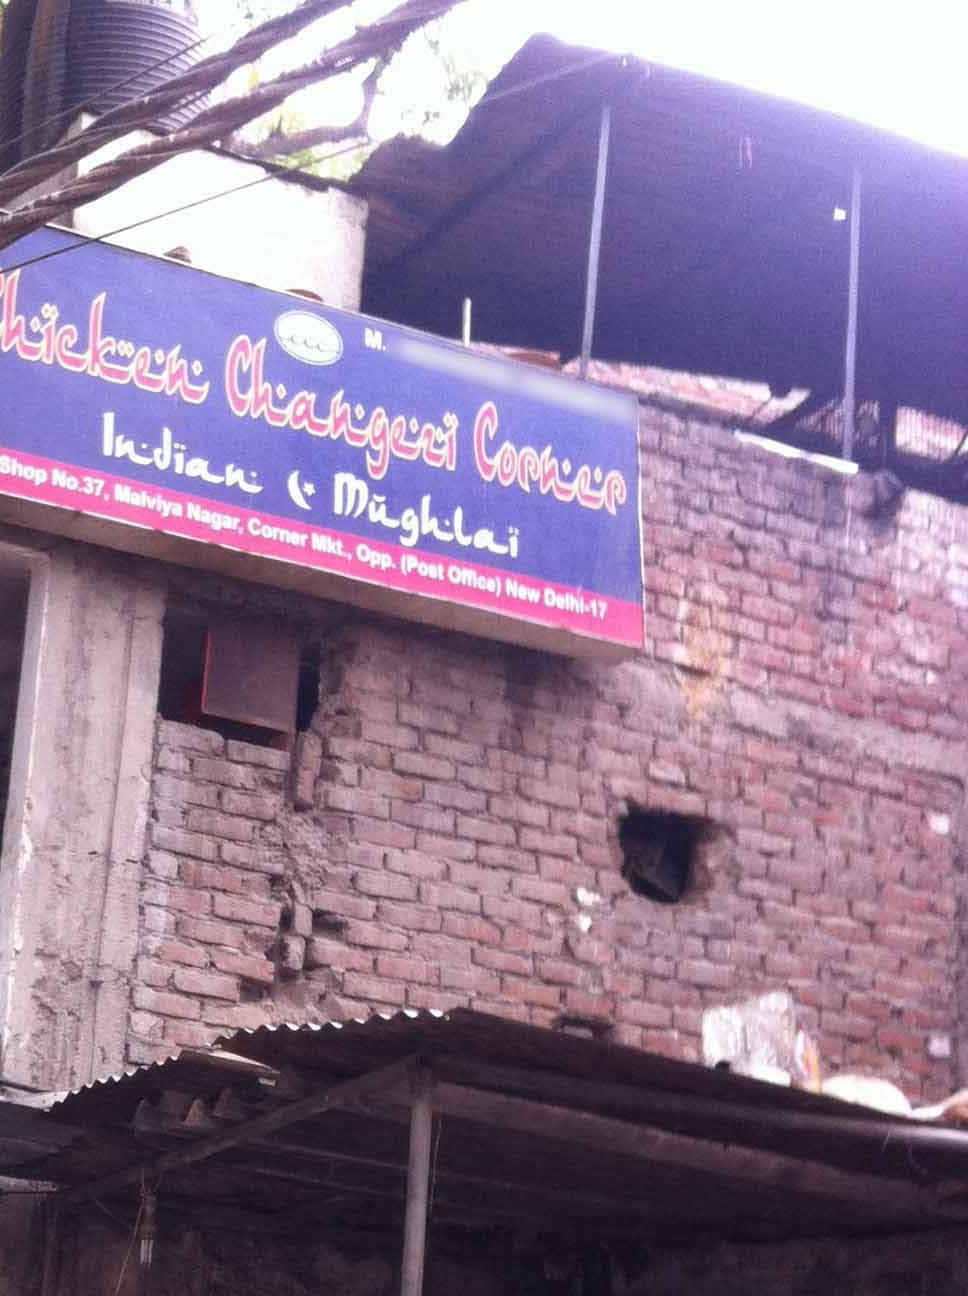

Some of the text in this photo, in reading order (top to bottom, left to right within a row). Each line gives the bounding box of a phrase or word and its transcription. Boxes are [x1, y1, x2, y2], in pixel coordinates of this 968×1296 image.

[102, 411, 519, 559] Indian Mughlai
[473, 400, 627, 516] Corner
[114, 484, 184, 518] Malviya
[186, 501, 245, 535] Nagar,
[247, 517, 309, 549] Corner
[355, 543, 397, 571] Opp.
[504, 577, 540, 604] New
[543, 586, 608, 621] Delhi-17
